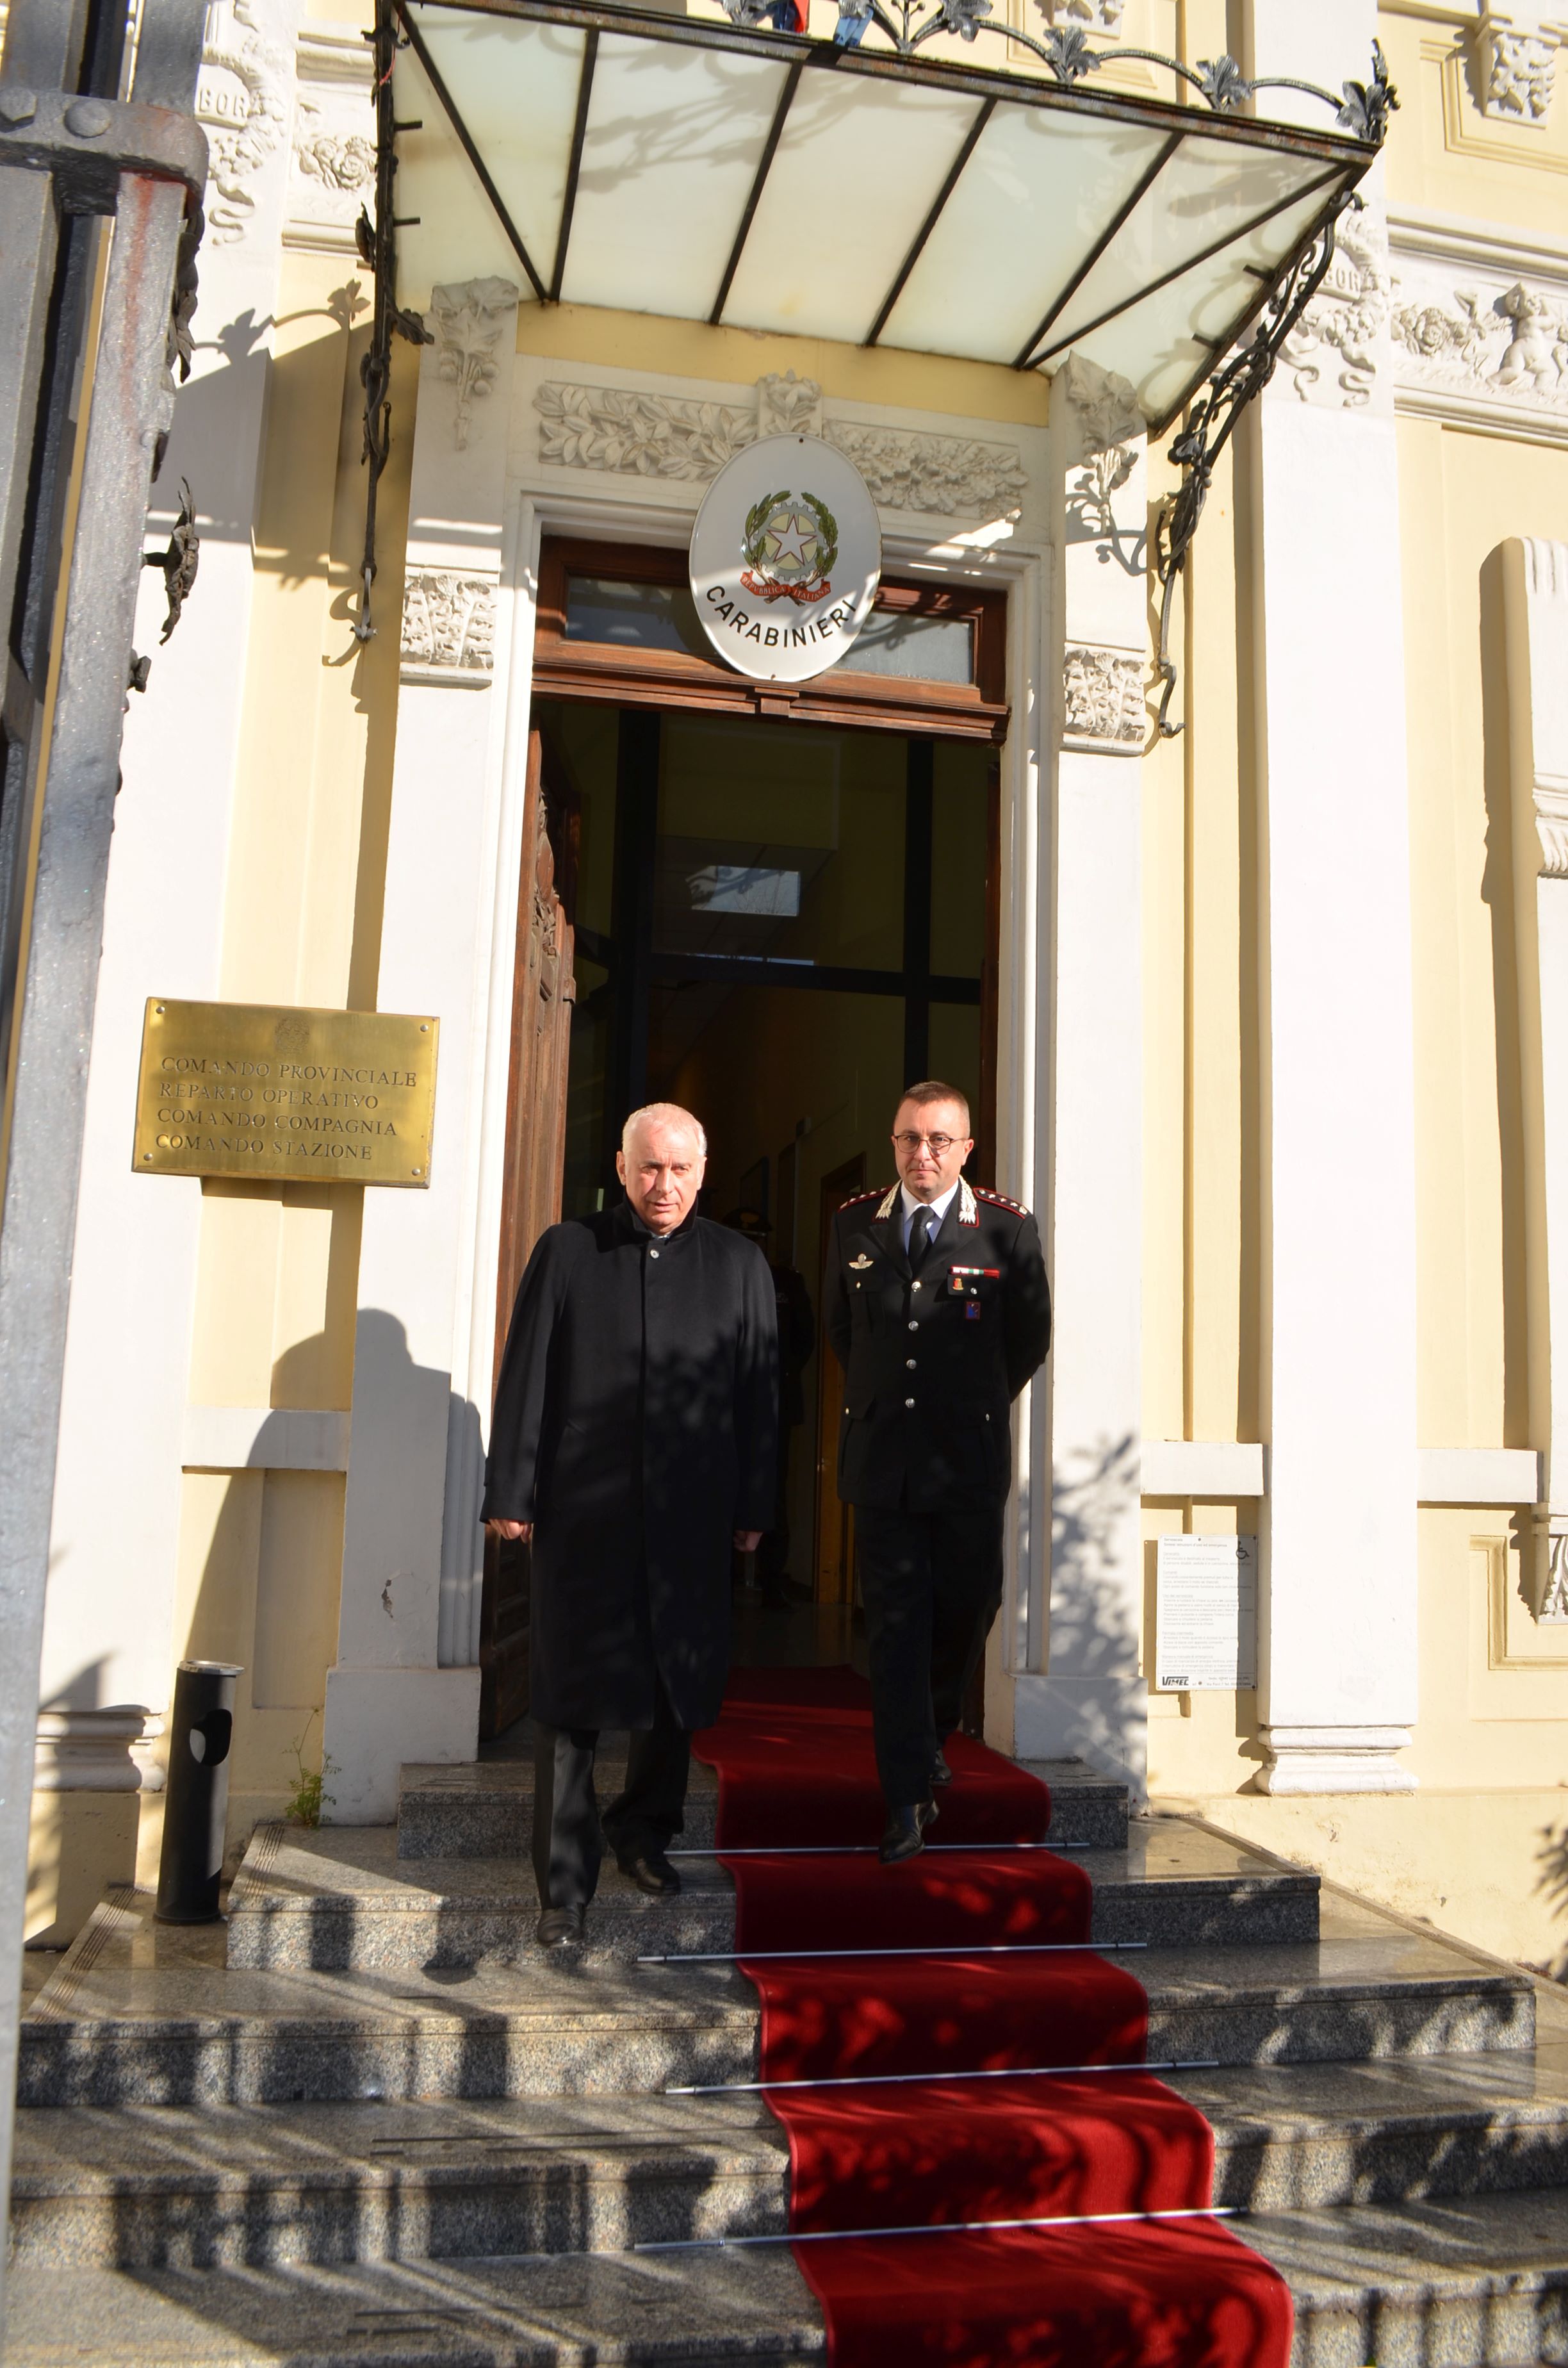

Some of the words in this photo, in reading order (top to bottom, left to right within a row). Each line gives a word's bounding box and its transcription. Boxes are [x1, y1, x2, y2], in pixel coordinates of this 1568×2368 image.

[794, 586, 830, 601] ITALIANA
[706, 586, 856, 648] CARABINIERI
[161, 1057, 270, 1077] COMANDO
[279, 1064, 417, 1087] PROVINCIALE
[160, 1081, 254, 1102] REPARTO
[263, 1089, 379, 1110] OPERATIVO
[158, 1108, 266, 1128] COMANDO
[275, 1115, 398, 1137] COMPAGNIA
[156, 1133, 264, 1153] COMANDO
[273, 1140, 372, 1161] STAZIONE
[1162, 1676, 1189, 1686] VIMEC
